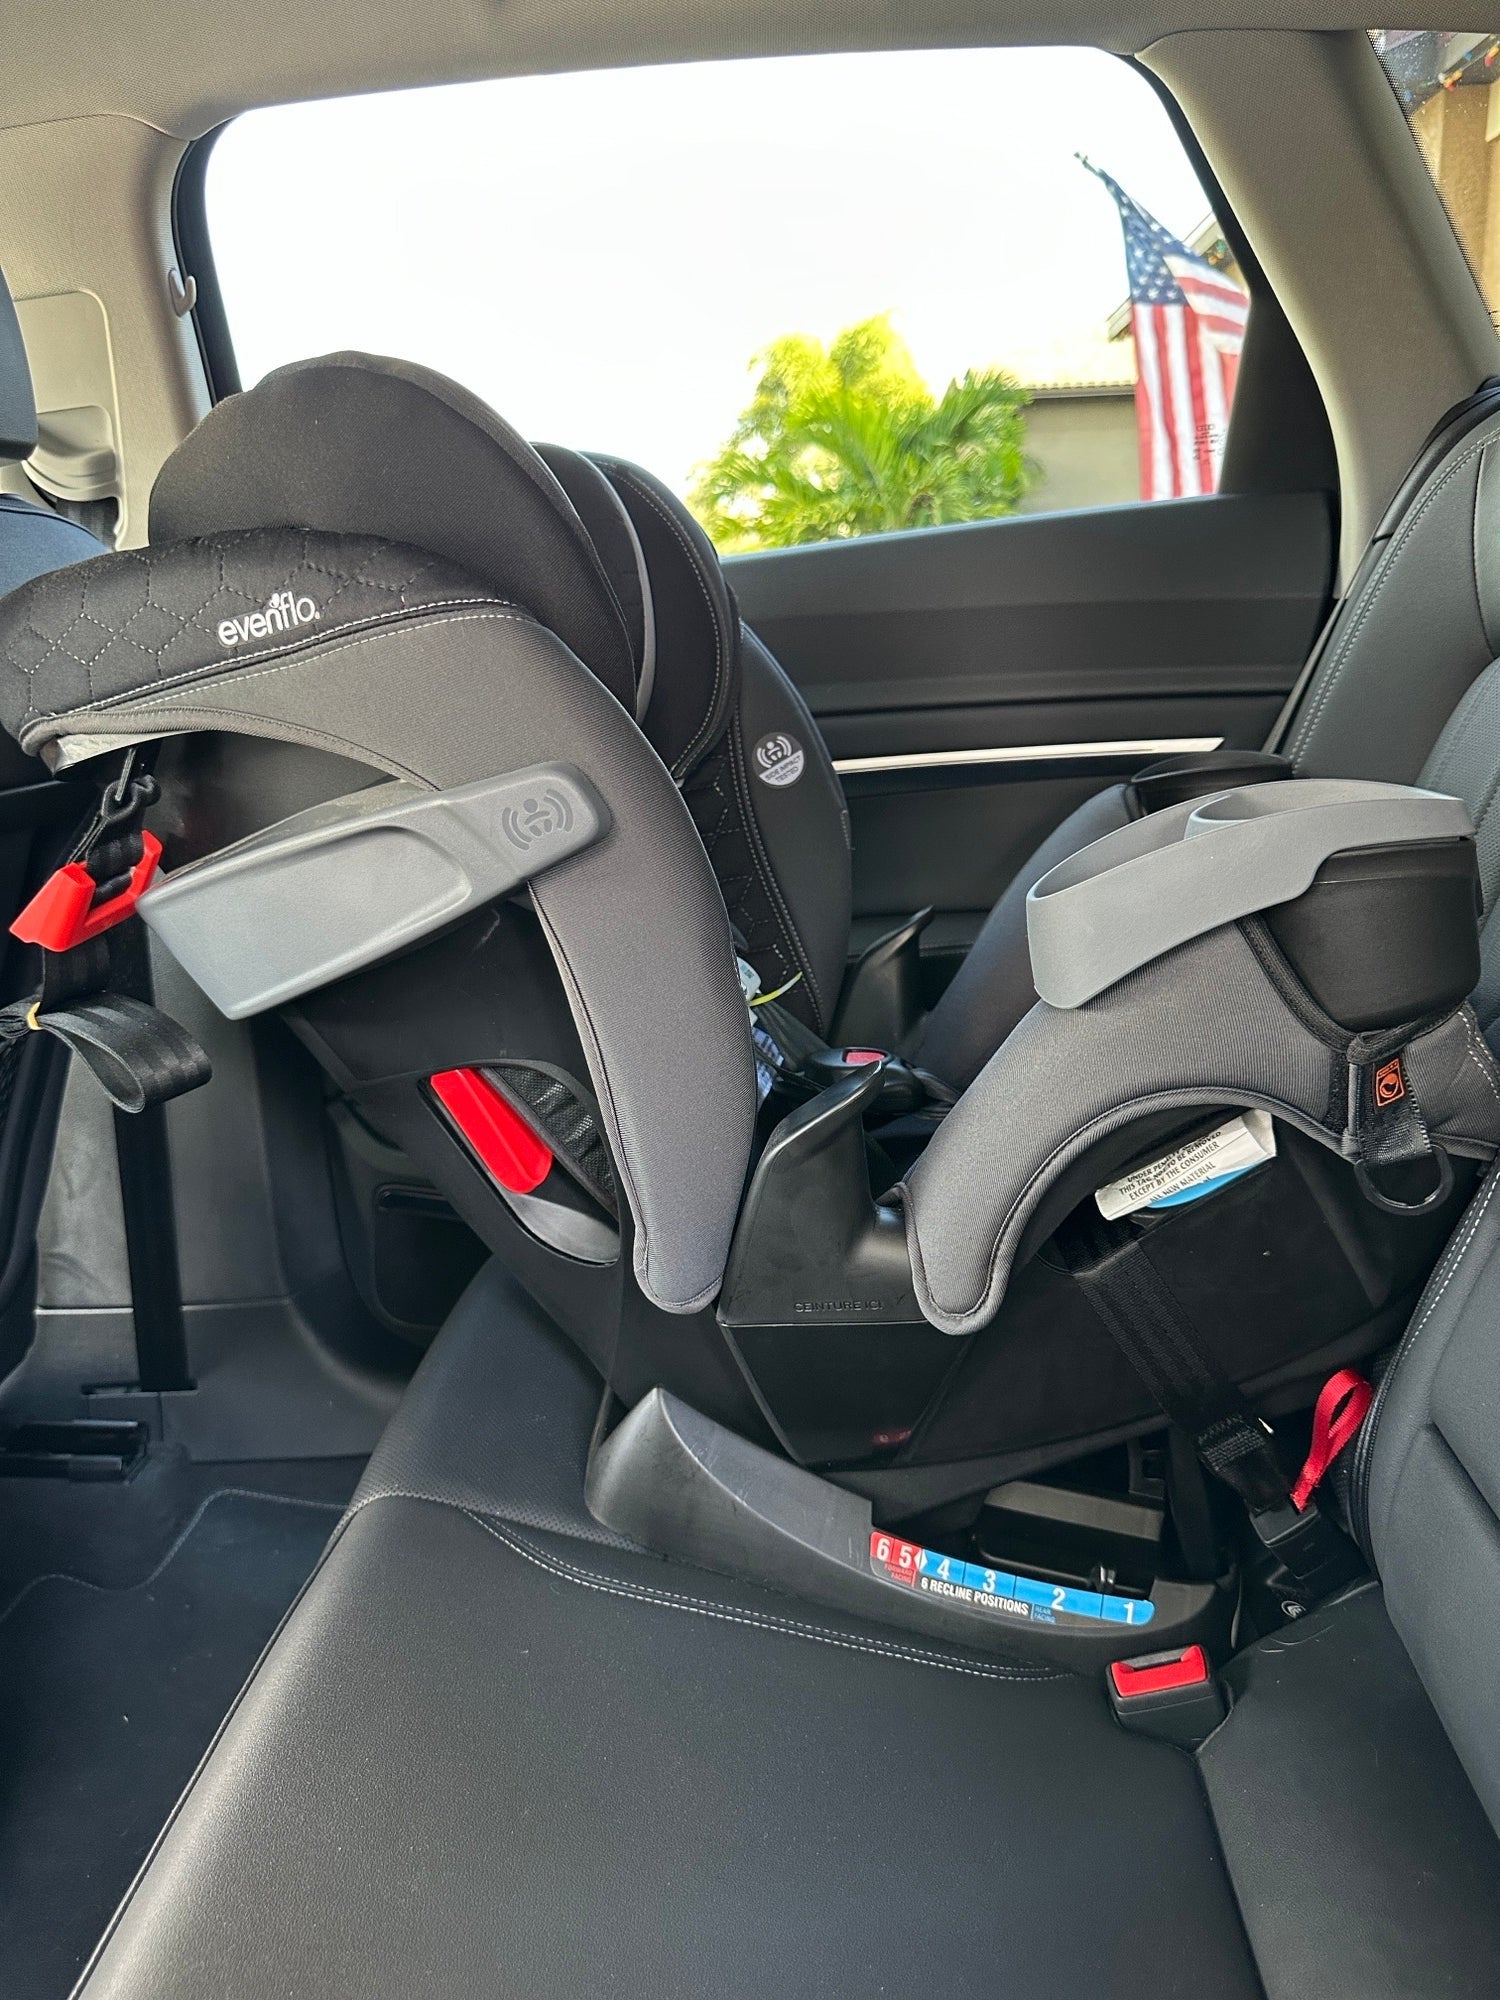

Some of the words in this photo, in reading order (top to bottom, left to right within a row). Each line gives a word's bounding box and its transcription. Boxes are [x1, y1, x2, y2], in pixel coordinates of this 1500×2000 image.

[218, 591, 315, 646] evenflo
[1119, 1183, 1136, 1195] THIS
[1137, 1176, 1152, 1186] TAG
[1167, 1159, 1176, 1167] TO
[1177, 1152, 1187, 1161] BE
[1186, 1131, 1222, 1155] REMOVED
[1127, 1168, 1152, 1182] UNDER
[1128, 1181, 1158, 1201] EXCEPT
[1157, 1175, 1167, 1185] BY
[1166, 1166, 1180, 1179] THE
[1180, 1141, 1220, 1169] CONSUMER
[1162, 1183, 1181, 1195] NEW
[1181, 1161, 1216, 1187] MATERIAL
[793, 1301, 862, 1313] CEINTURE
[877, 1537, 890, 1562] 6
[898, 1545, 912, 1569] 5
[936, 1558, 951, 1581] 4
[982, 1569, 997, 1593] 3
[1051, 1587, 1066, 1611] 2
[1124, 1602, 1134, 1624] 1
[921, 1577, 929, 1590] 6
[929, 1579, 973, 1602] RECLINE
[973, 1589, 1029, 1616] POSITIONS
